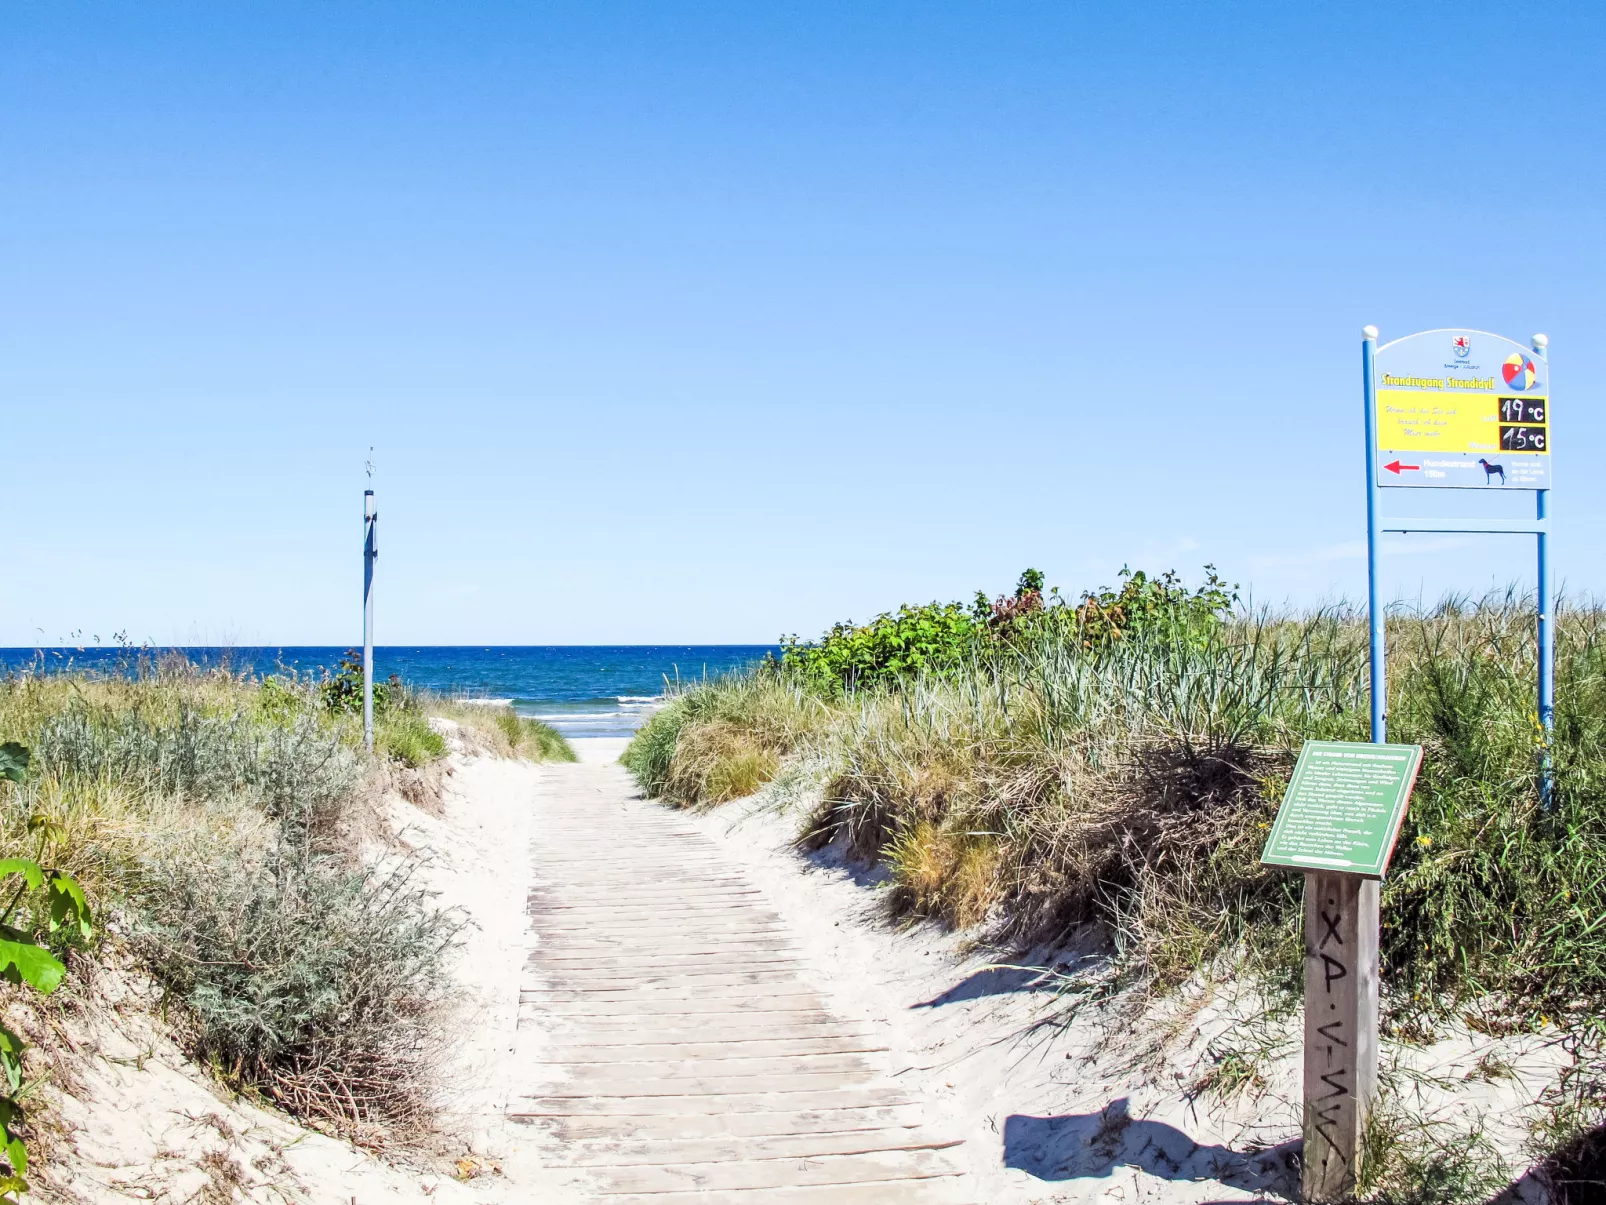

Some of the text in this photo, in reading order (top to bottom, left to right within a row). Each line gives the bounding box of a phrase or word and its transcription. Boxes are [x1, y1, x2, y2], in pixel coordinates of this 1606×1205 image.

[1381, 373, 1495, 390] Strandzugang Strandidyll
[1501, 398, 1524, 422] 19
[1502, 427, 1527, 450] 15
